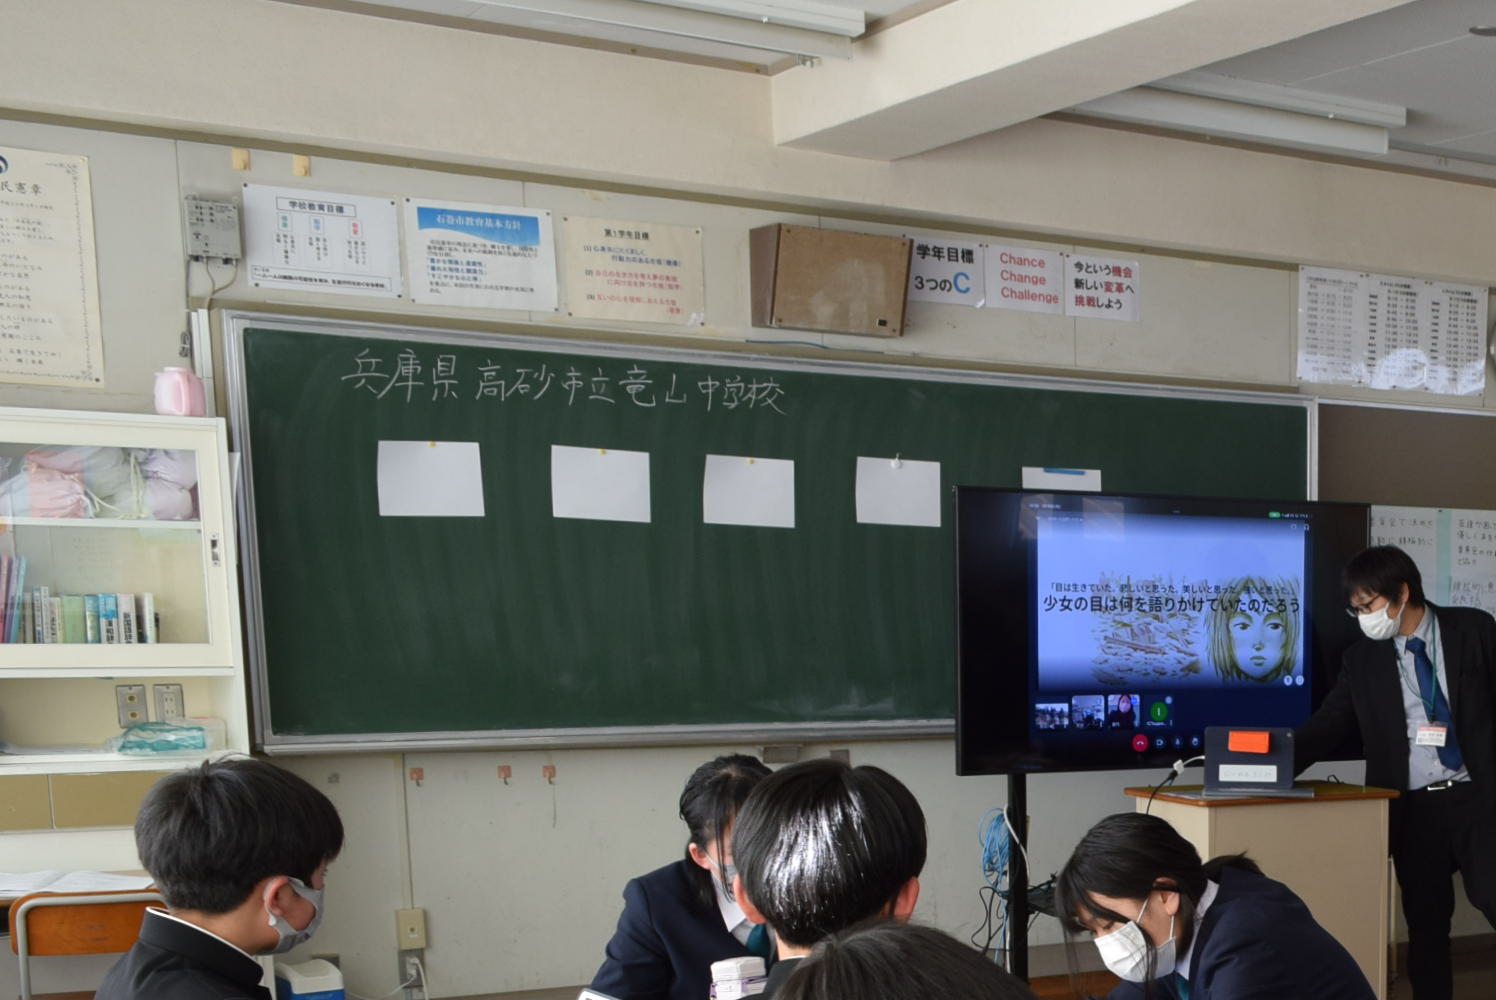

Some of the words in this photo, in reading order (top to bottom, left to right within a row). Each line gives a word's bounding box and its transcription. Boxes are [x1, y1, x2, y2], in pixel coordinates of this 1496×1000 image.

[288, 200, 345, 214] 学校教育目標
[435, 213, 523, 231] 石巻市教育基本方針
[604, 228, 650, 241] 第1学年目標
[916, 243, 975, 264] 学年目標
[1000, 252, 1046, 269] Chance
[1000, 269, 1047, 286] Change
[1073, 261, 1133, 279] 今という機会
[914, 271, 971, 294] 3つのC
[1074, 278, 1135, 294] 新しい変革へ
[1001, 286, 1059, 305] Challenge
[1074, 295, 1123, 310] 挑戦しよう
[1043, 595, 1300, 613] 少女の目は何を語りかけていたのだろう
